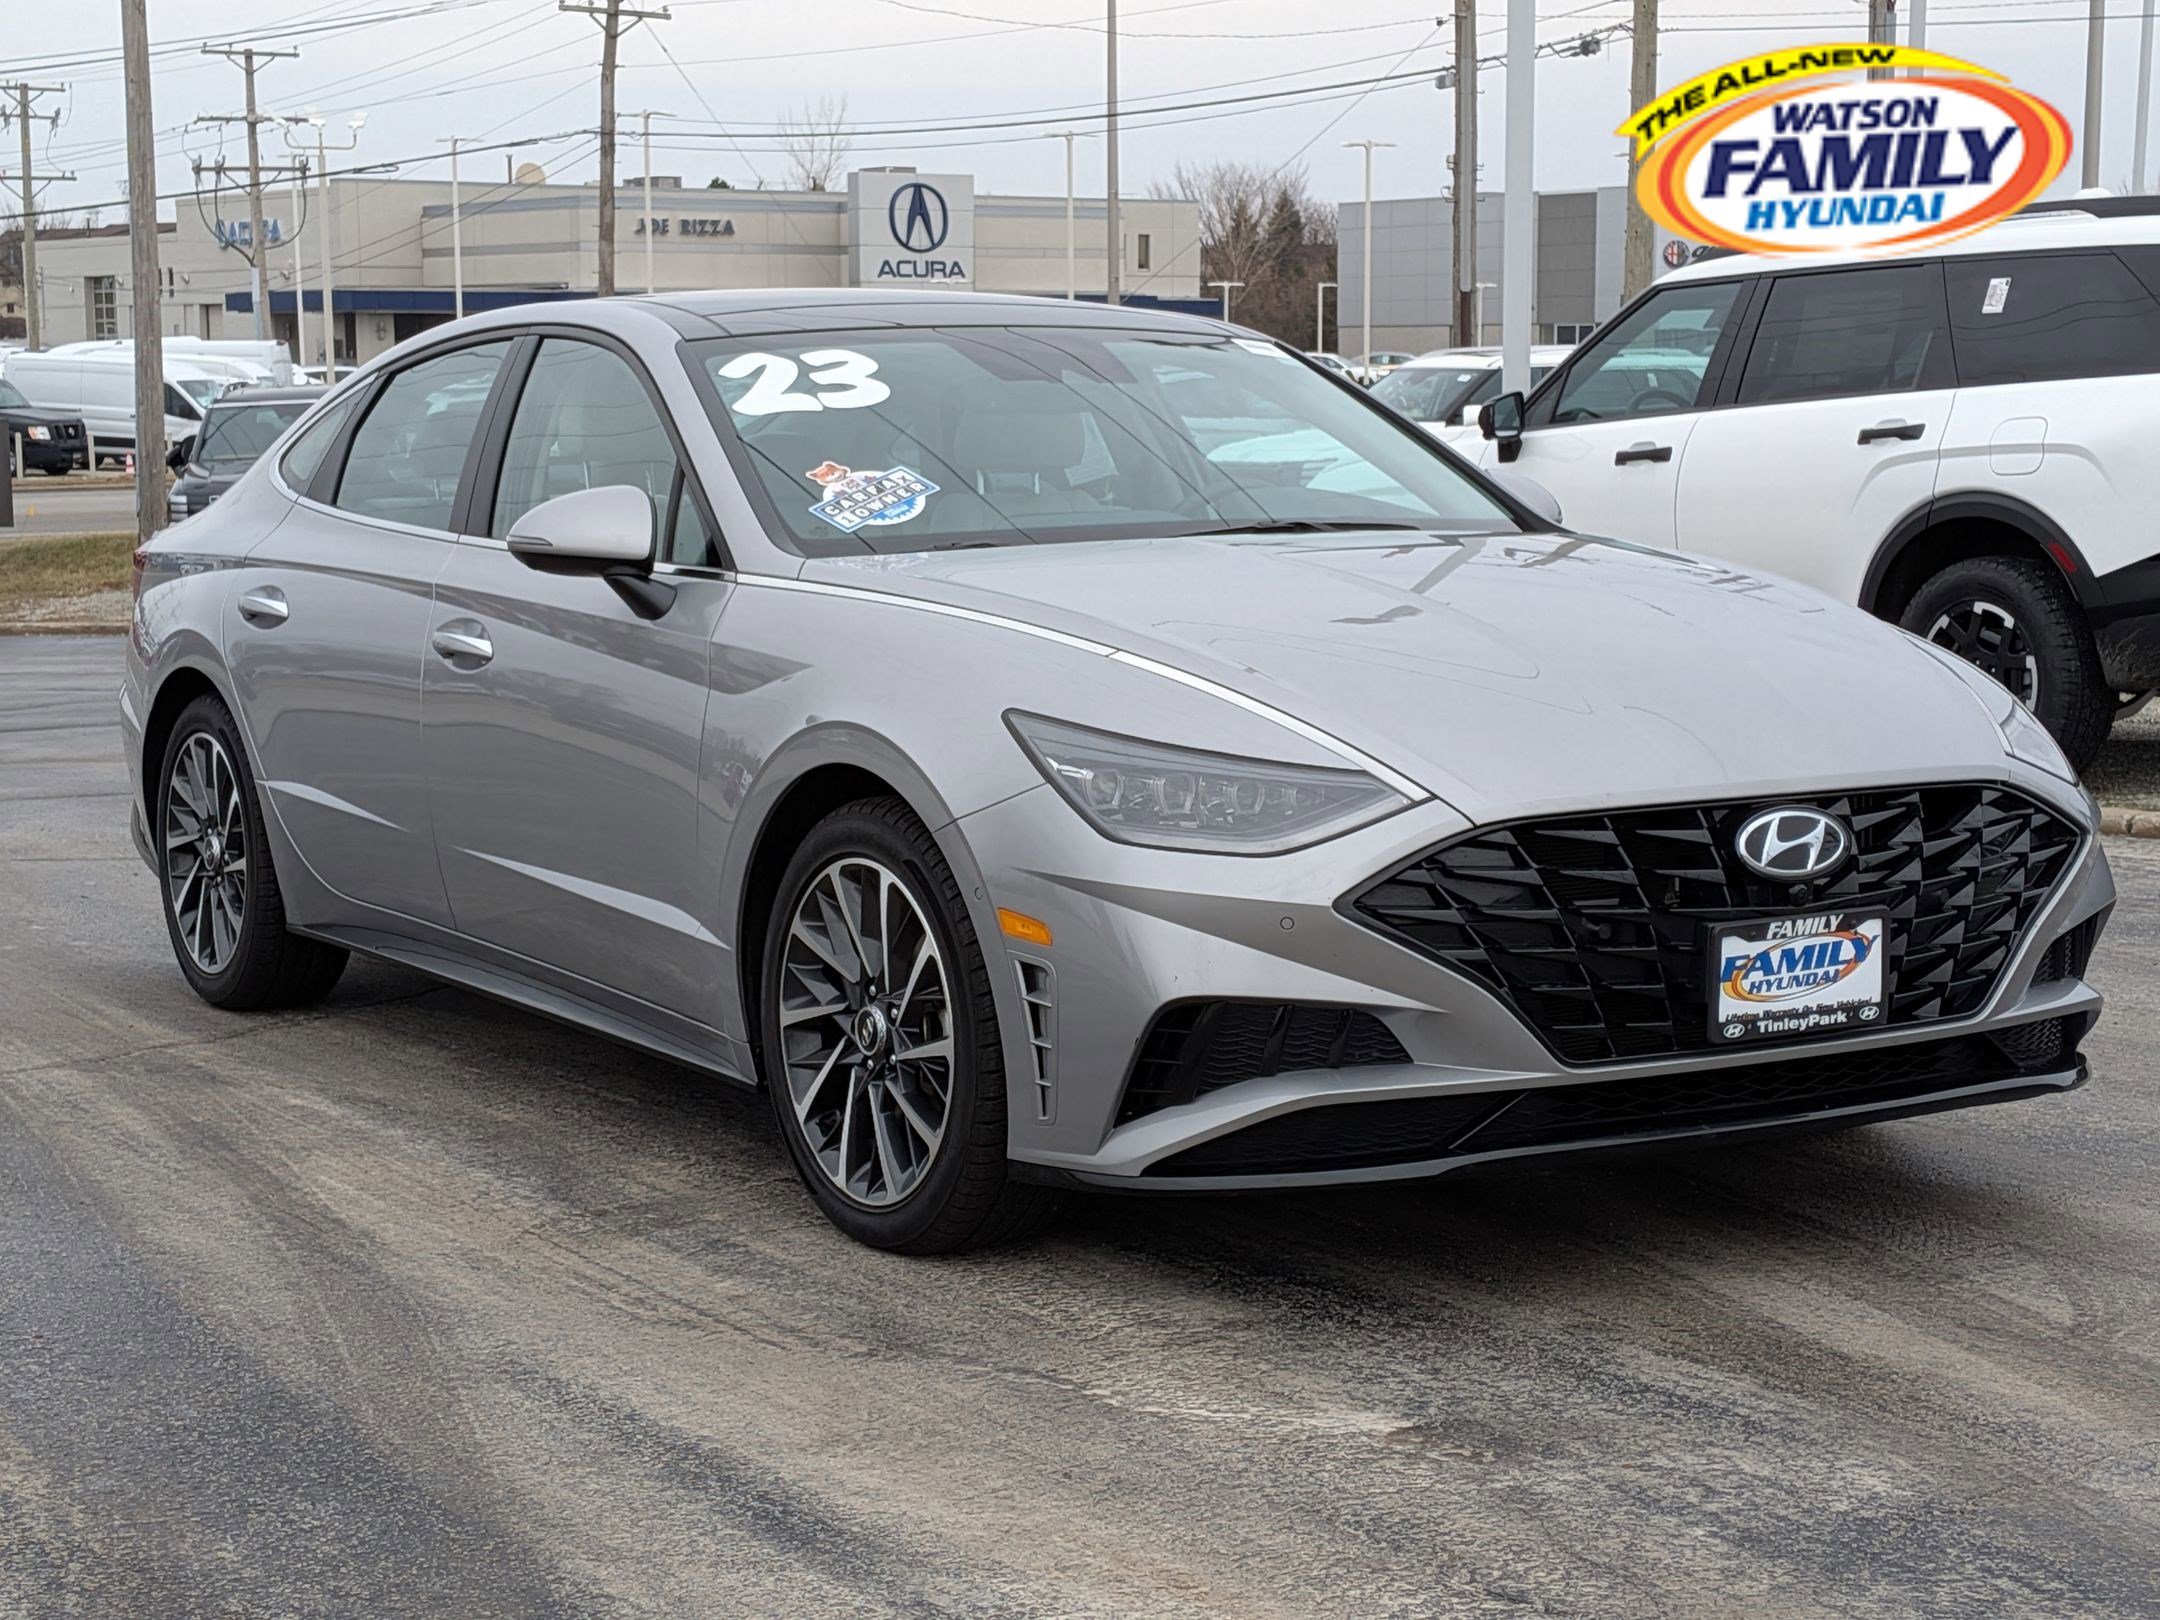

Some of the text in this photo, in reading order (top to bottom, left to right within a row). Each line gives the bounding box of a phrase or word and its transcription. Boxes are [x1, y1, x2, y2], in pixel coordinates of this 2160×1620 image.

[679, 218, 736, 237] RIZZA
[877, 259, 966, 278] ACURA
[718, 349, 891, 415] 23
[824, 475, 911, 516] CARFAX
[1766, 914, 1844, 940] FAMILY
[1720, 934, 1880, 983] FAMILY
[1749, 969, 1840, 995] HYUNDAI
[1757, 1010, 1848, 1033] TinleyPark
